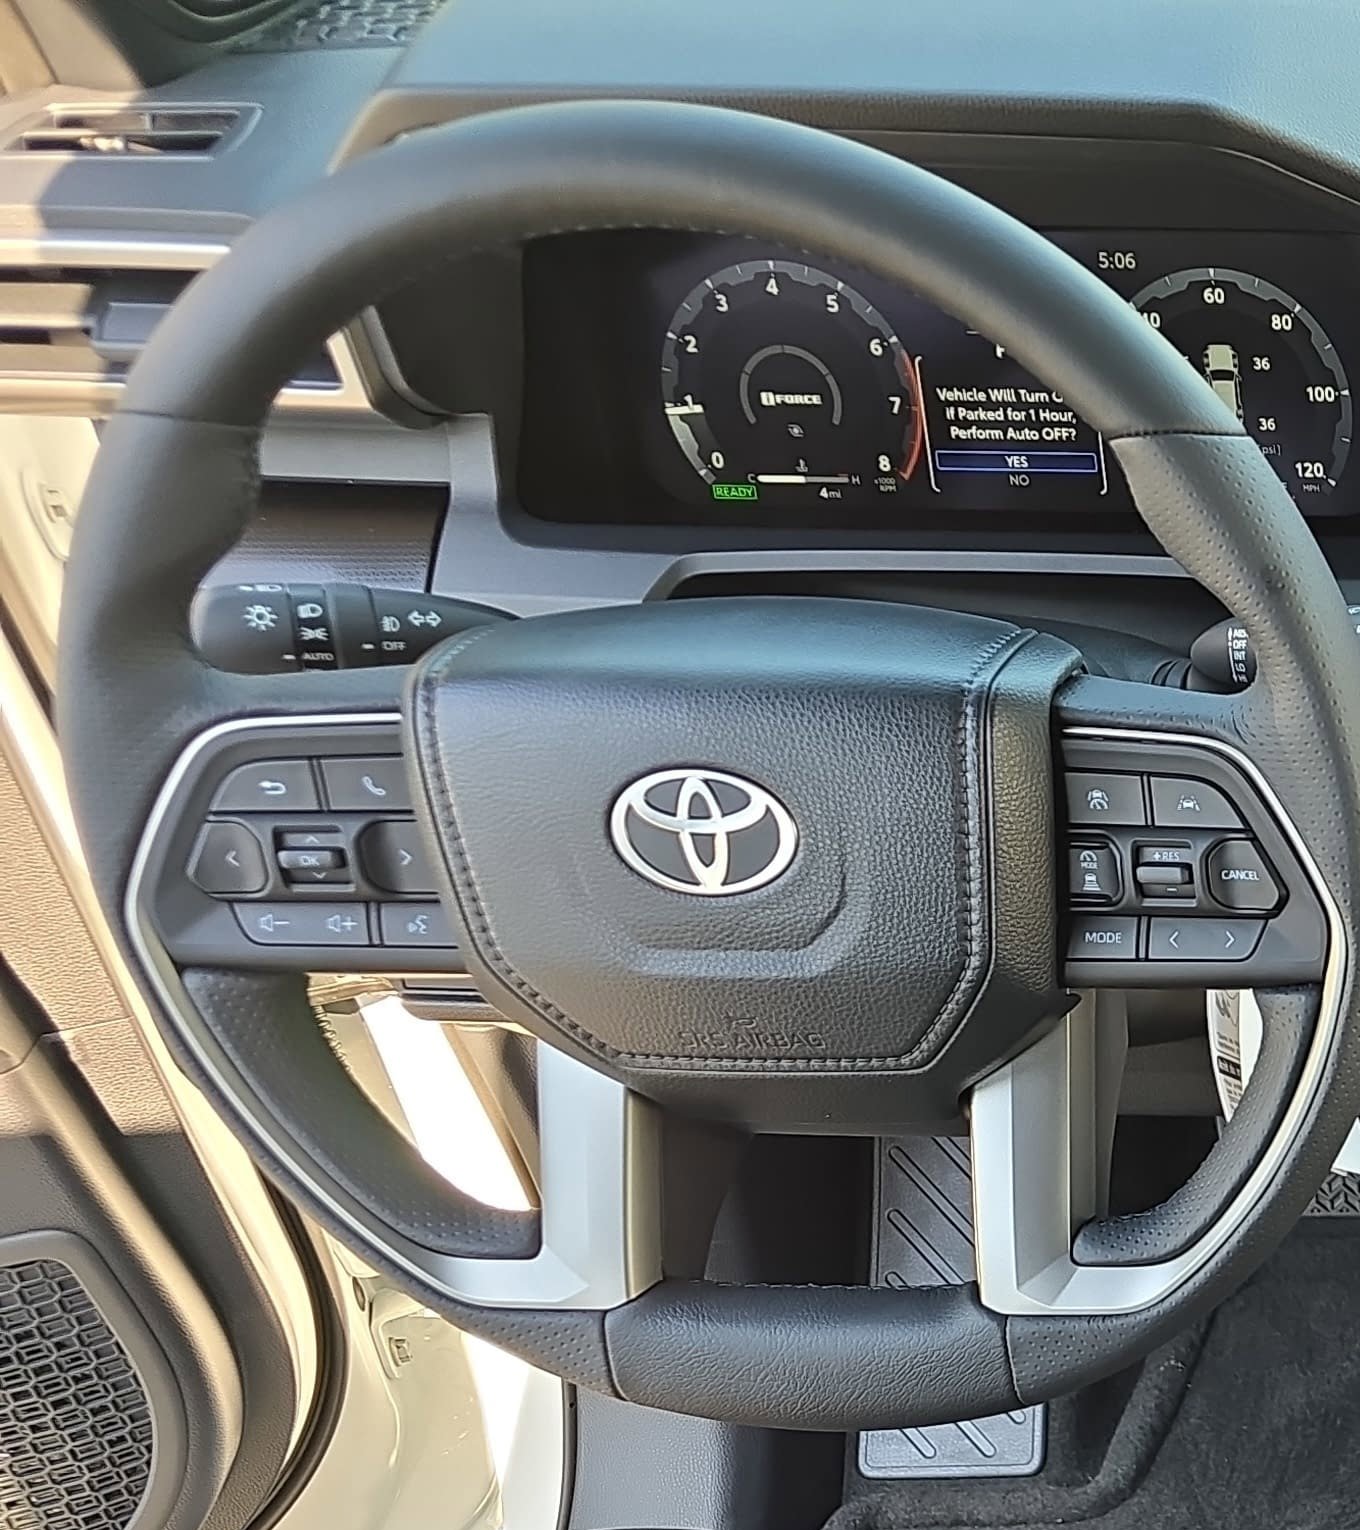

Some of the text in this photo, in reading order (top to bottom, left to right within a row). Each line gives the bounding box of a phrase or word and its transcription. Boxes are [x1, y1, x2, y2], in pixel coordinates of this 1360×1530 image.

[1098, 252, 1136, 269] 5:06
[766, 278, 779, 295] 4
[715, 294, 729, 313] 3
[1203, 288, 1225, 304] 60
[826, 296, 839, 313] 5
[1271, 314, 1293, 331] 80
[685, 335, 699, 353] 2
[869, 339, 883, 356] 6
[1252, 357, 1271, 371] 36
[684, 394, 694, 410] 1
[936, 387, 987, 402] Vehicle
[987, 388, 1016, 403] Will
[1018, 389, 1049, 403] Turn
[1306, 386, 1335, 403] 100
[888, 396, 901, 414] 7
[946, 407, 1077, 424] If Parked for 1 Hour,
[1259, 418, 1276, 432] 36
[950, 426, 1077, 441] Perform Auto OFF?
[711, 452, 724, 469] 0
[878, 455, 891, 471] 8
[1004, 456, 1029, 468] YES
[1295, 462, 1323, 478] 120
[851, 475, 861, 485] H
[1009, 474, 1030, 486] NO
[716, 487, 753, 497] READY
[1303, 484, 1320, 493] MPH
[381, 641, 406, 651] OFF
[1233, 640, 1247, 650] OFF
[302, 652, 334, 661] AUTO
[301, 855, 321, 867] OK
[1221, 870, 1259, 881] CANCEL
[1085, 932, 1122, 943] MODE
[678, 1031, 826, 1049] SRS AIRBAG
